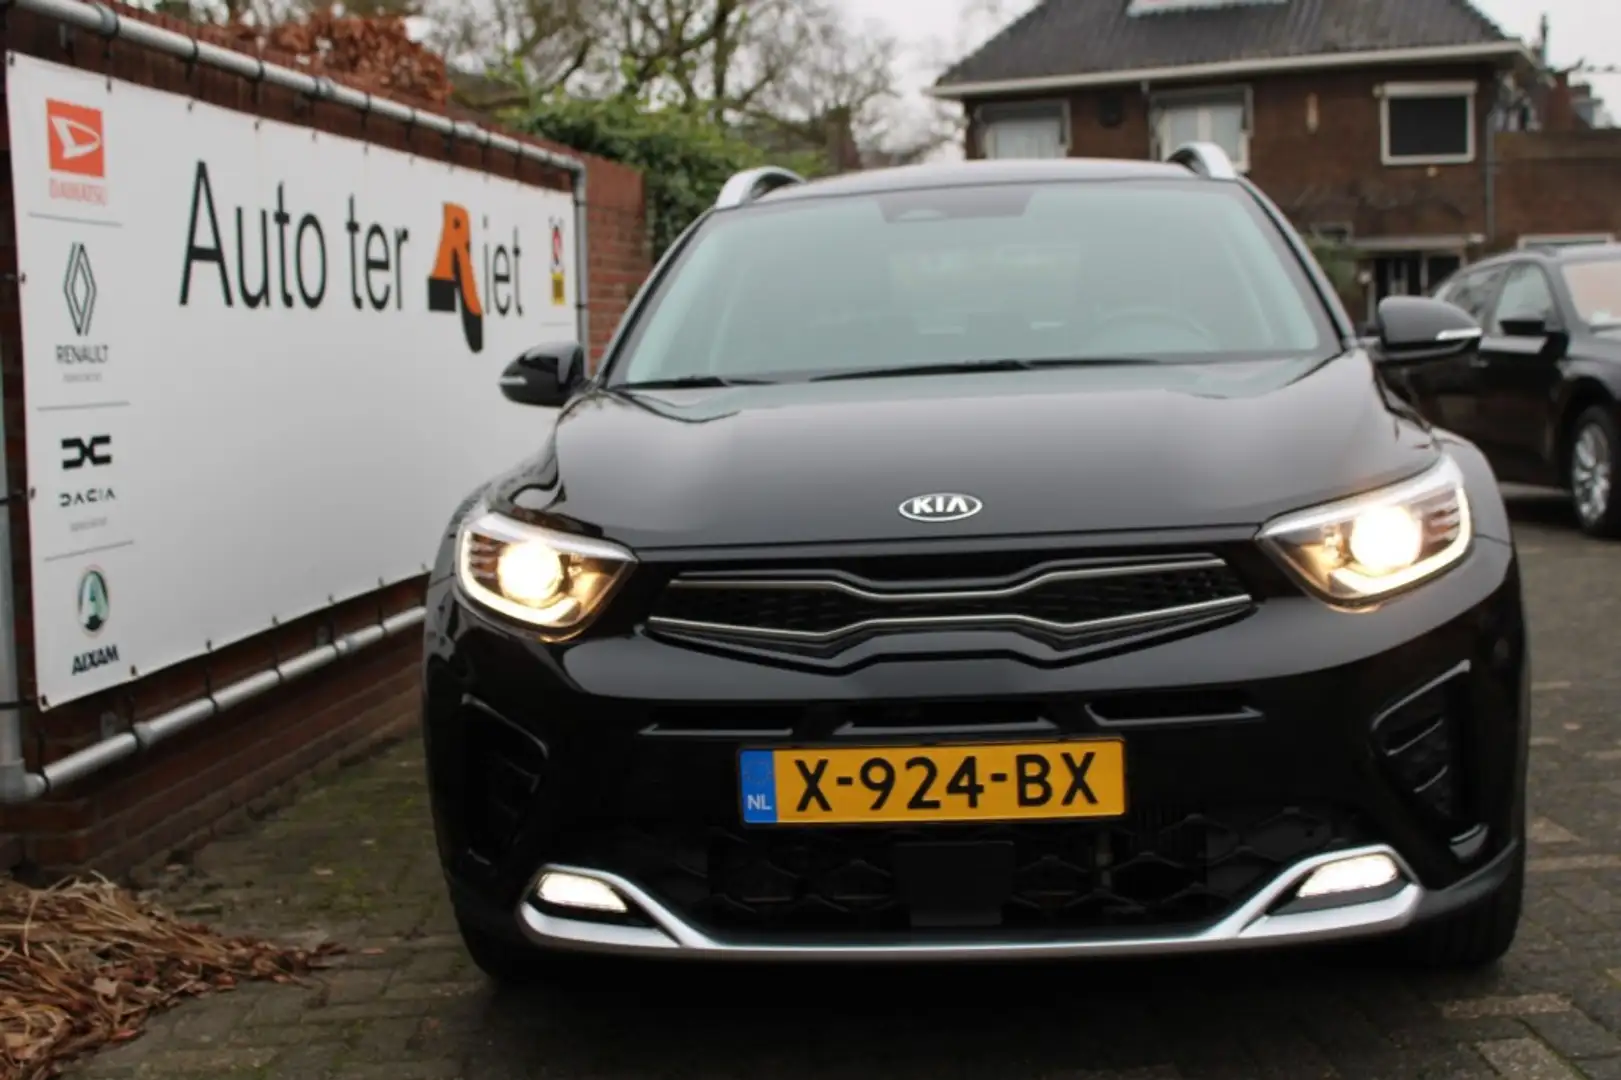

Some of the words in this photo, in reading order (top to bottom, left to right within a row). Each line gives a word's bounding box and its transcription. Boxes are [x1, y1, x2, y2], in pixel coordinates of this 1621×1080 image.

[179, 160, 327, 310] Auto
[345, 193, 409, 311] ter
[428, 202, 523, 353] Riet
[56, 344, 109, 364] RENAULT
[59, 487, 116, 508] DACIA
[913, 496, 968, 514] KIA
[747, 794, 771, 810] NL
[794, 752, 1099, 812] X-924-BX
